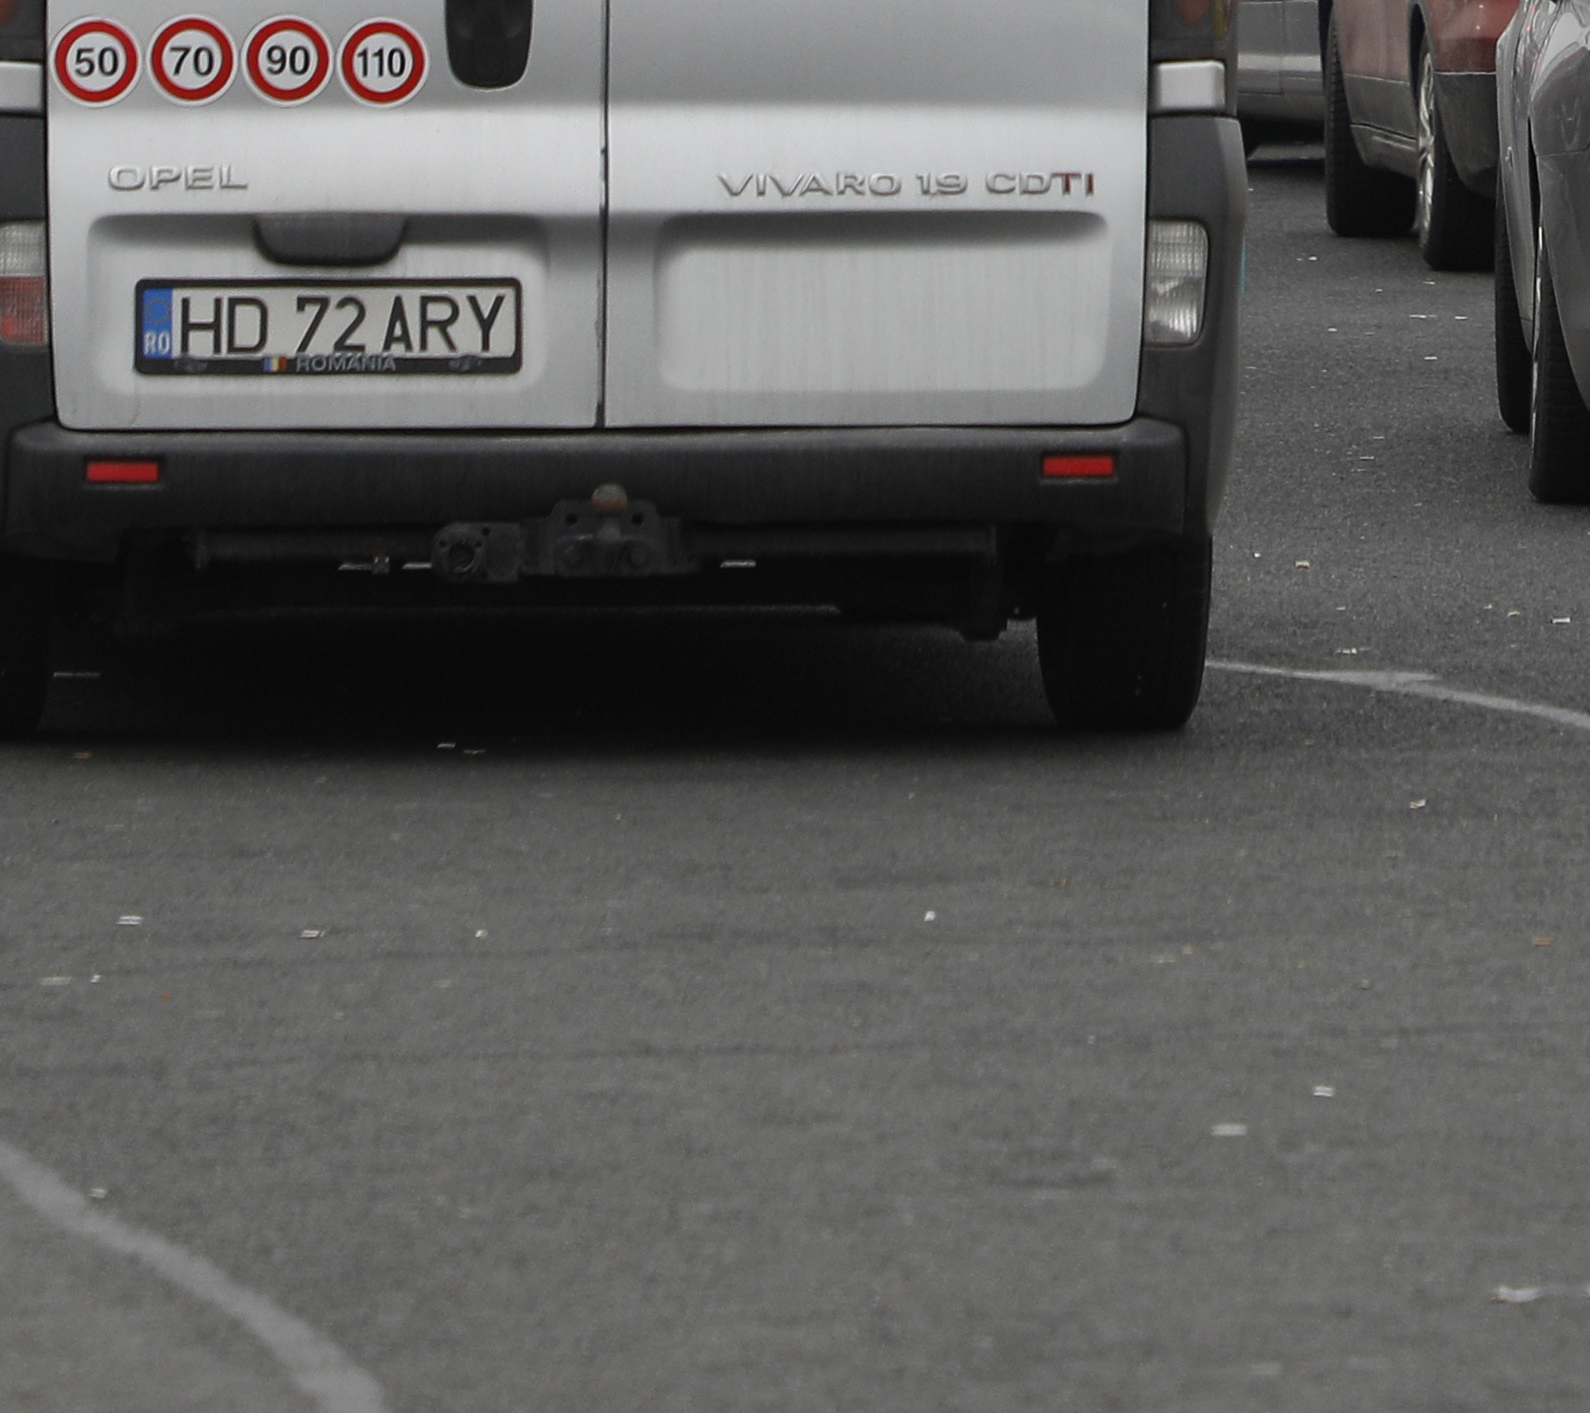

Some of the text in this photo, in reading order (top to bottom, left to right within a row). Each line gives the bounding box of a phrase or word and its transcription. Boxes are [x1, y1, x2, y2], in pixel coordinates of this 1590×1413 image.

[74, 46, 119, 75] 50
[169, 44, 215, 75] 70
[265, 44, 310, 75] 90
[356, 47, 406, 77] 110
[108, 164, 249, 190] OPEL
[718, 173, 901, 196] VIVARO
[985, 172, 1096, 196] CDTI
[181, 294, 506, 355] HD 72 ARY
[144, 331, 170, 354] RO
